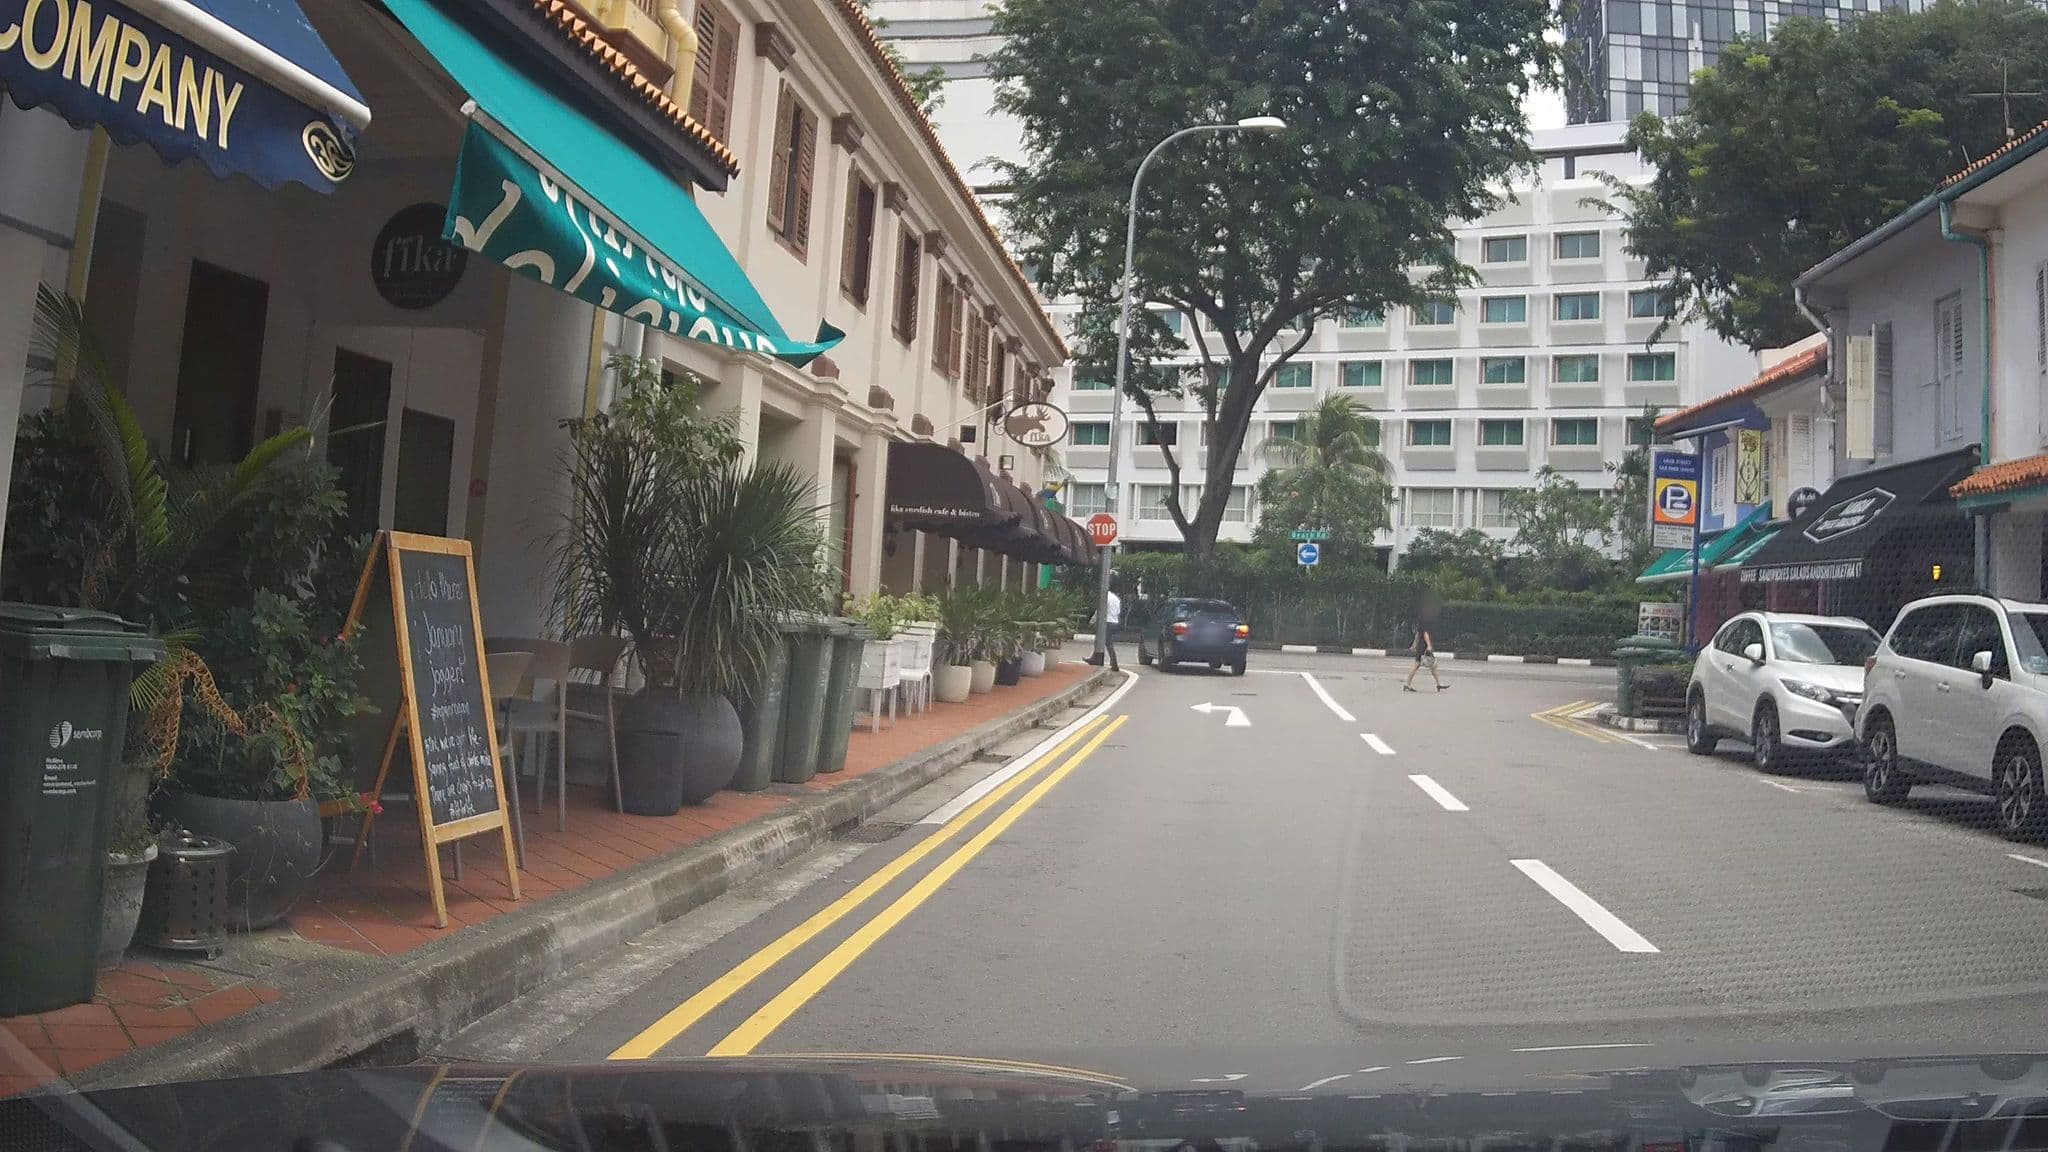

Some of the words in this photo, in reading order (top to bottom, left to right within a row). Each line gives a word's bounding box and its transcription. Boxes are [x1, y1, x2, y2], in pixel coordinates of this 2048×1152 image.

[1087, 522, 1116, 536] STOP
[422, 610, 466, 665] January
[73, 728, 103, 740] sembcorp
